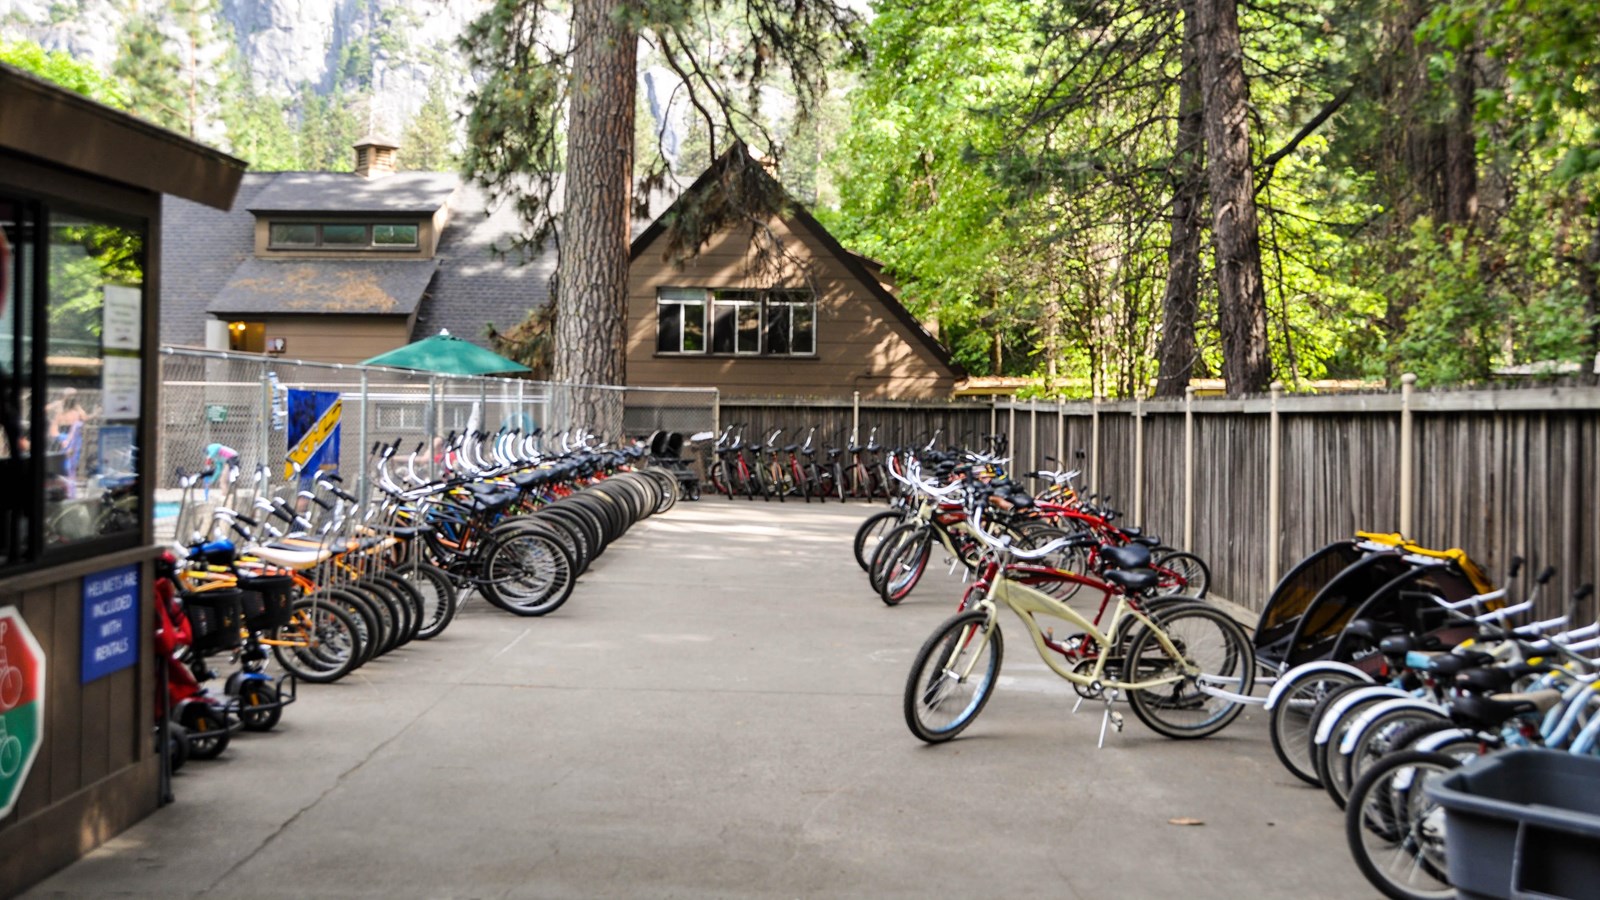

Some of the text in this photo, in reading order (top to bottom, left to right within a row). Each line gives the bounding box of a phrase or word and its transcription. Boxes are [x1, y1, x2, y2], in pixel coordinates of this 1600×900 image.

[87, 570, 138, 598] HELMETS ARE
[93, 593, 133, 618] INCLUDED
[101, 618, 123, 638] WITH
[95, 637, 129, 662] RENTALS
